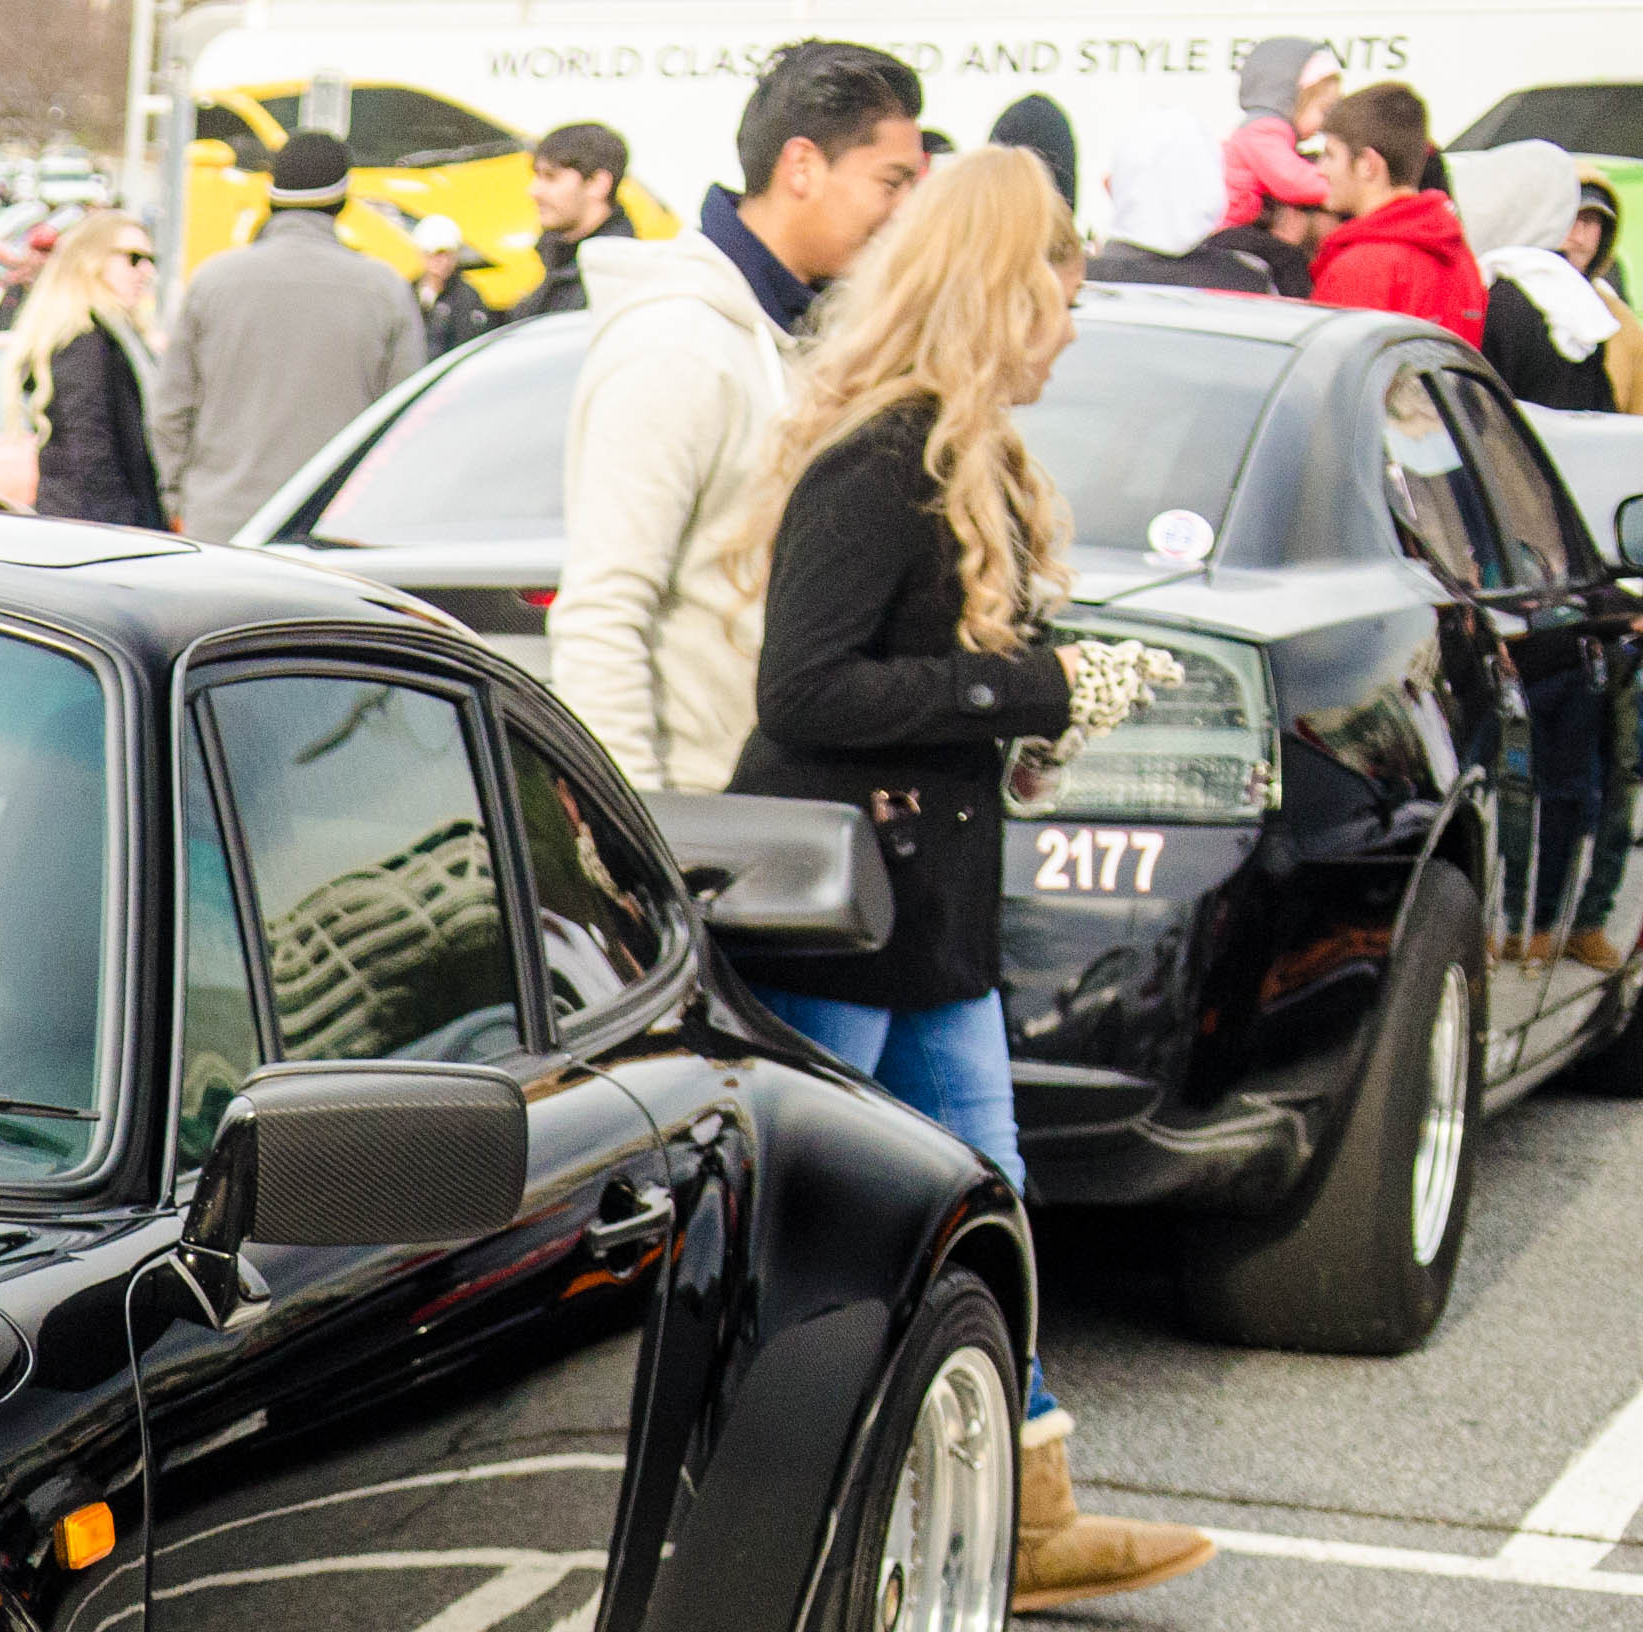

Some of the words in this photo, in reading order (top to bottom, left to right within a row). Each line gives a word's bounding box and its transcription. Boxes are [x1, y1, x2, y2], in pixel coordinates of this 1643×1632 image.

[490, 47, 642, 79] WORLD
[960, 40, 1062, 74] AND
[1078, 38, 1209, 73] STYLE
[1229, 36, 1410, 71] ENTS
[1034, 826, 1165, 895] 2177
